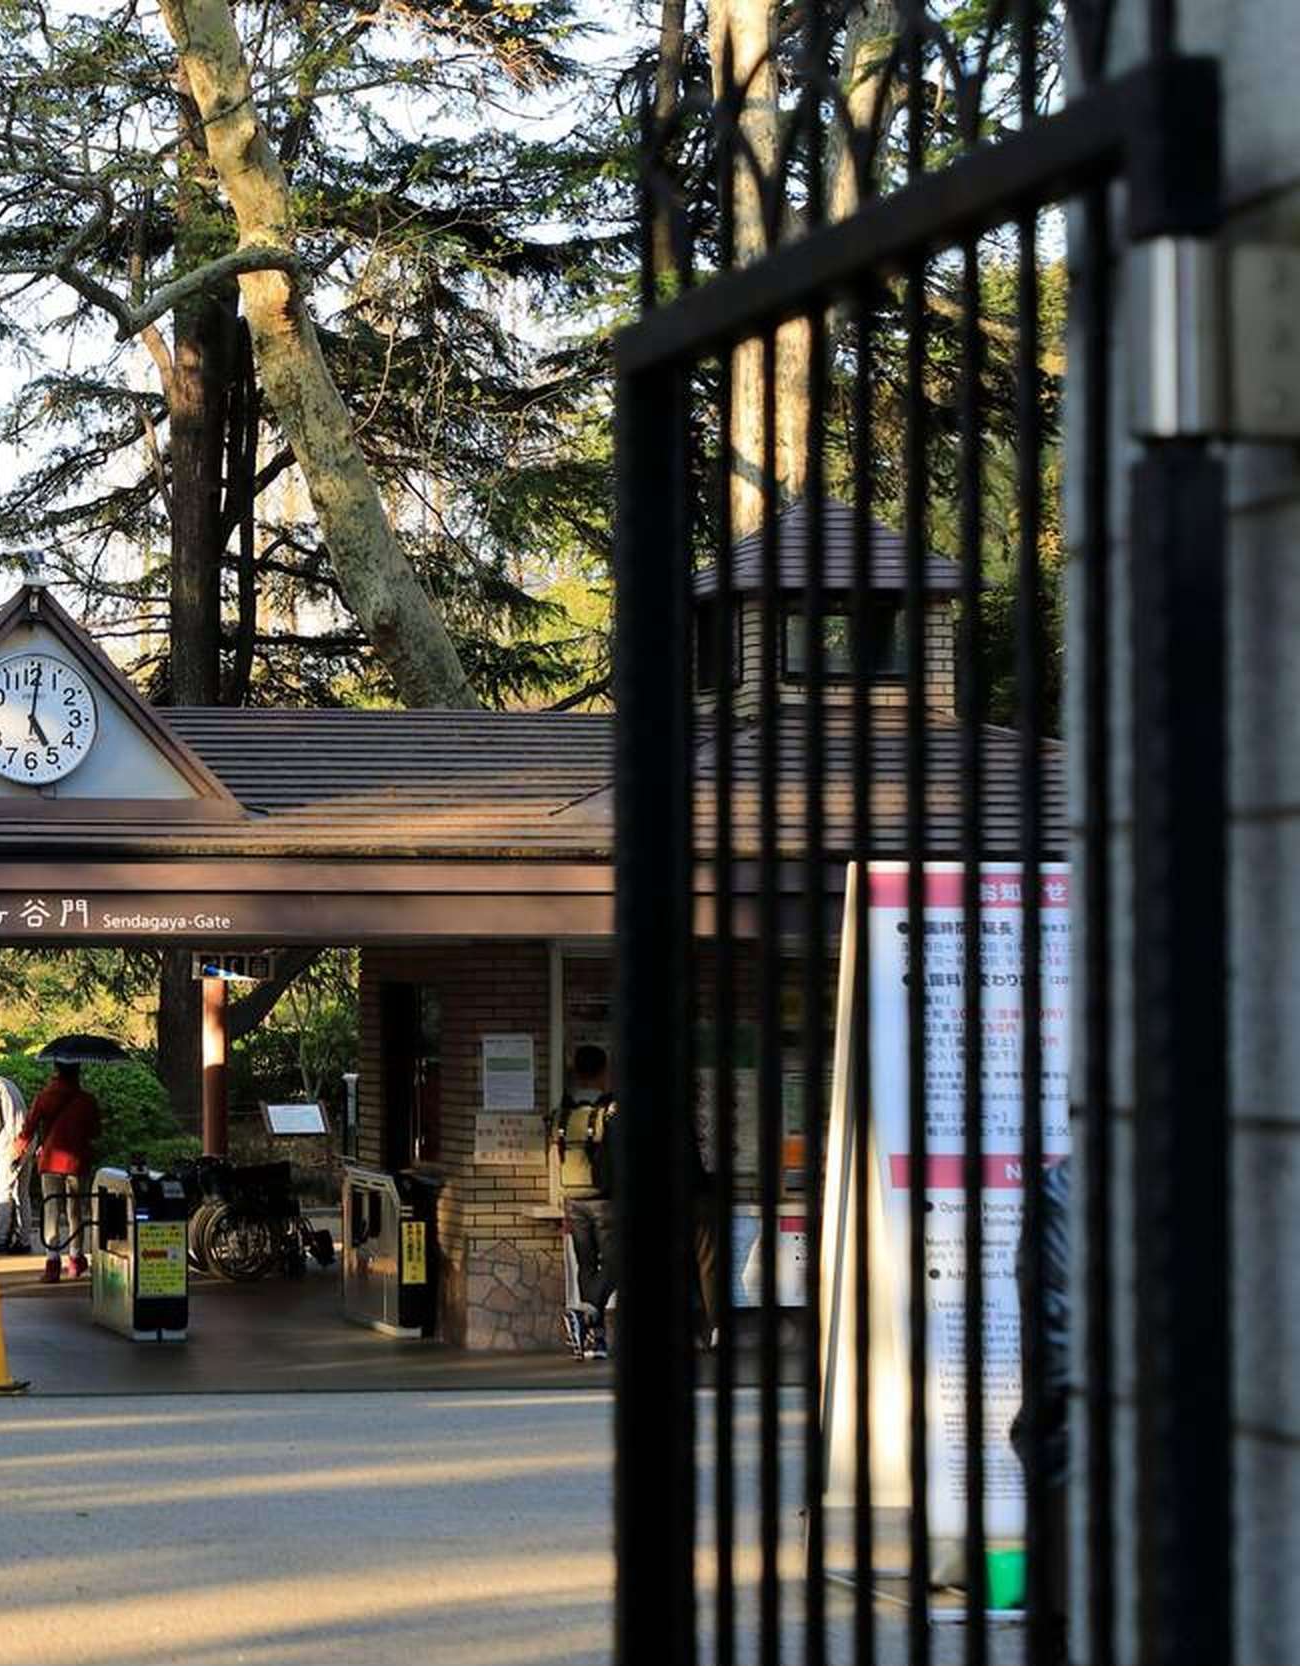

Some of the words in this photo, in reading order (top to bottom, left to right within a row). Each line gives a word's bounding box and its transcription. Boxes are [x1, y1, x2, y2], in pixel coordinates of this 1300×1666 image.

[6, 672, 19, 690] 11
[24, 667, 43, 687] 12
[63, 688, 76, 706] 2
[68, 710, 82, 728] 3
[62, 731, 75, 748] 4
[5, 747, 18, 765] 7
[24, 752, 38, 770] 6
[46, 747, 59, 765] 5
[980, 883, 1068, 902] お知せ
